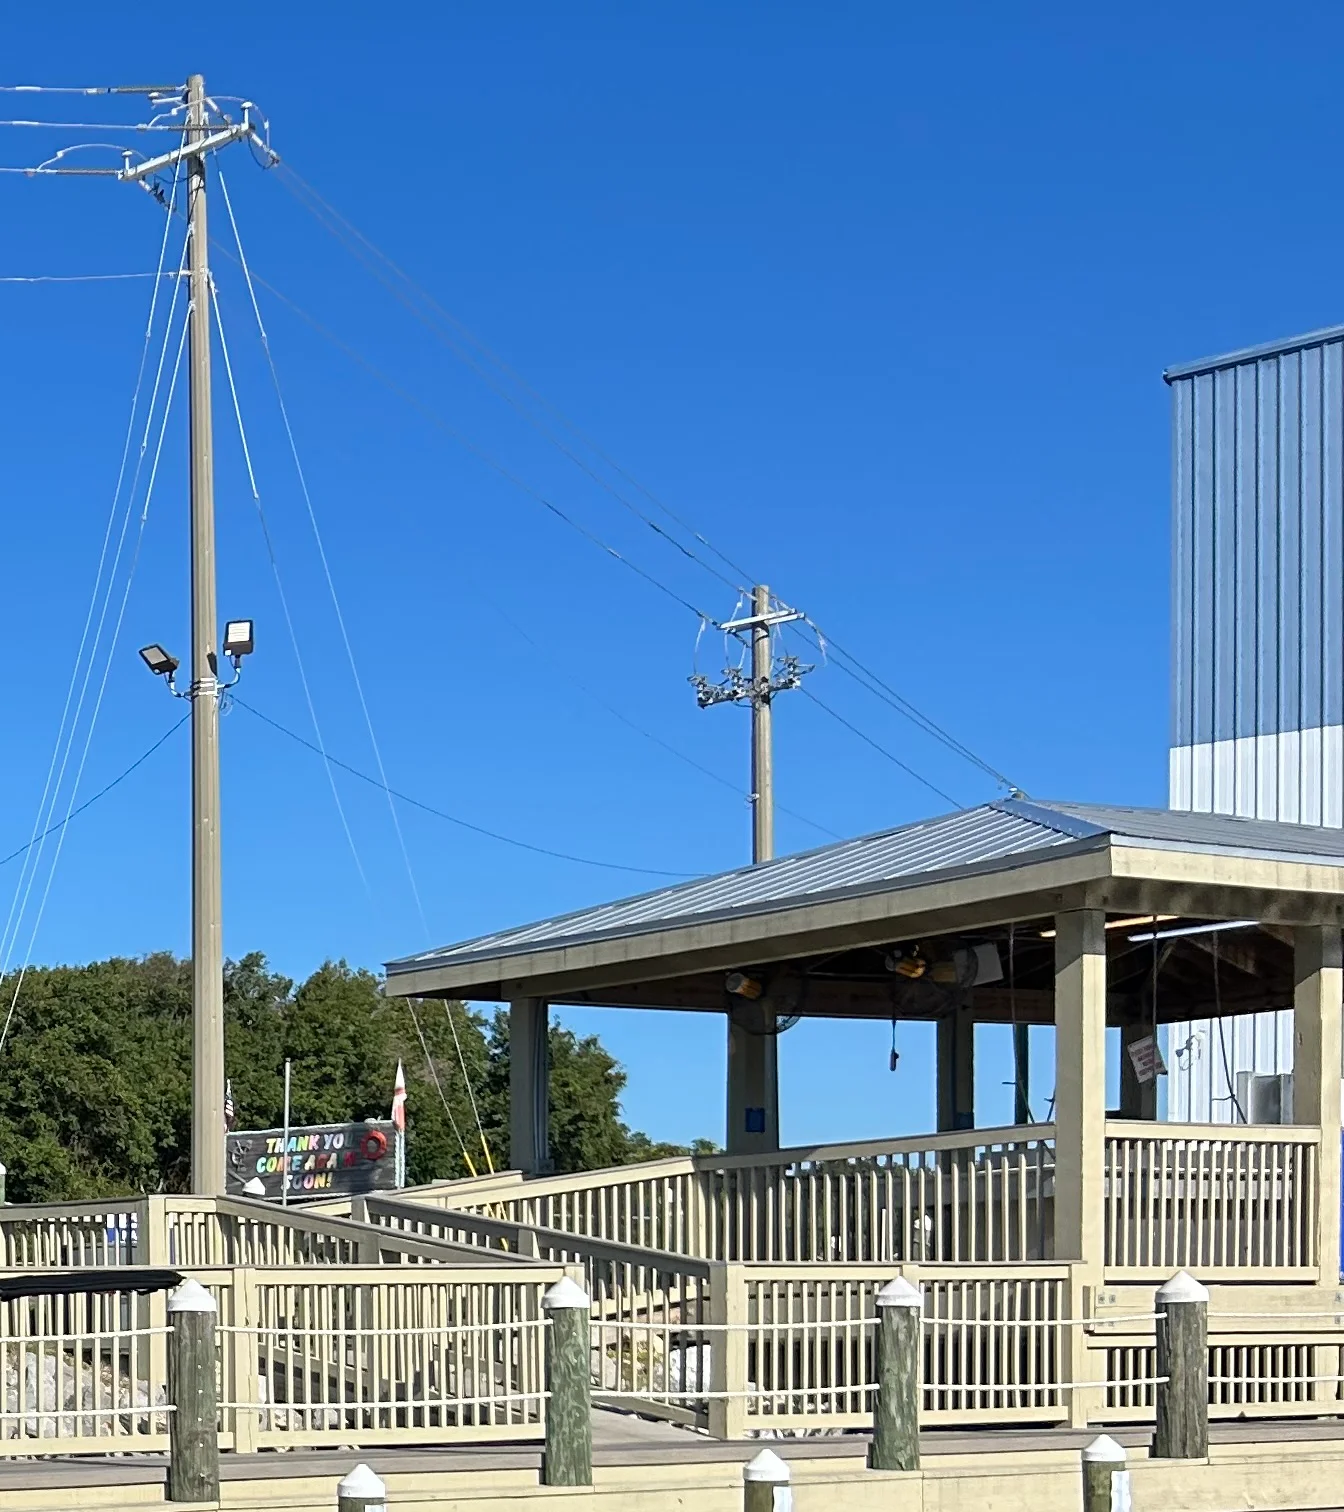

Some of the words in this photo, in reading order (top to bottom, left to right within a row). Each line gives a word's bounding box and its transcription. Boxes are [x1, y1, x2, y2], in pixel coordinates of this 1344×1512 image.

[265, 1134, 320, 1154] THANK
[256, 1155, 303, 1174] COME
[304, 1151, 356, 1171] AGAIN
[280, 1172, 333, 1190] SOON!
